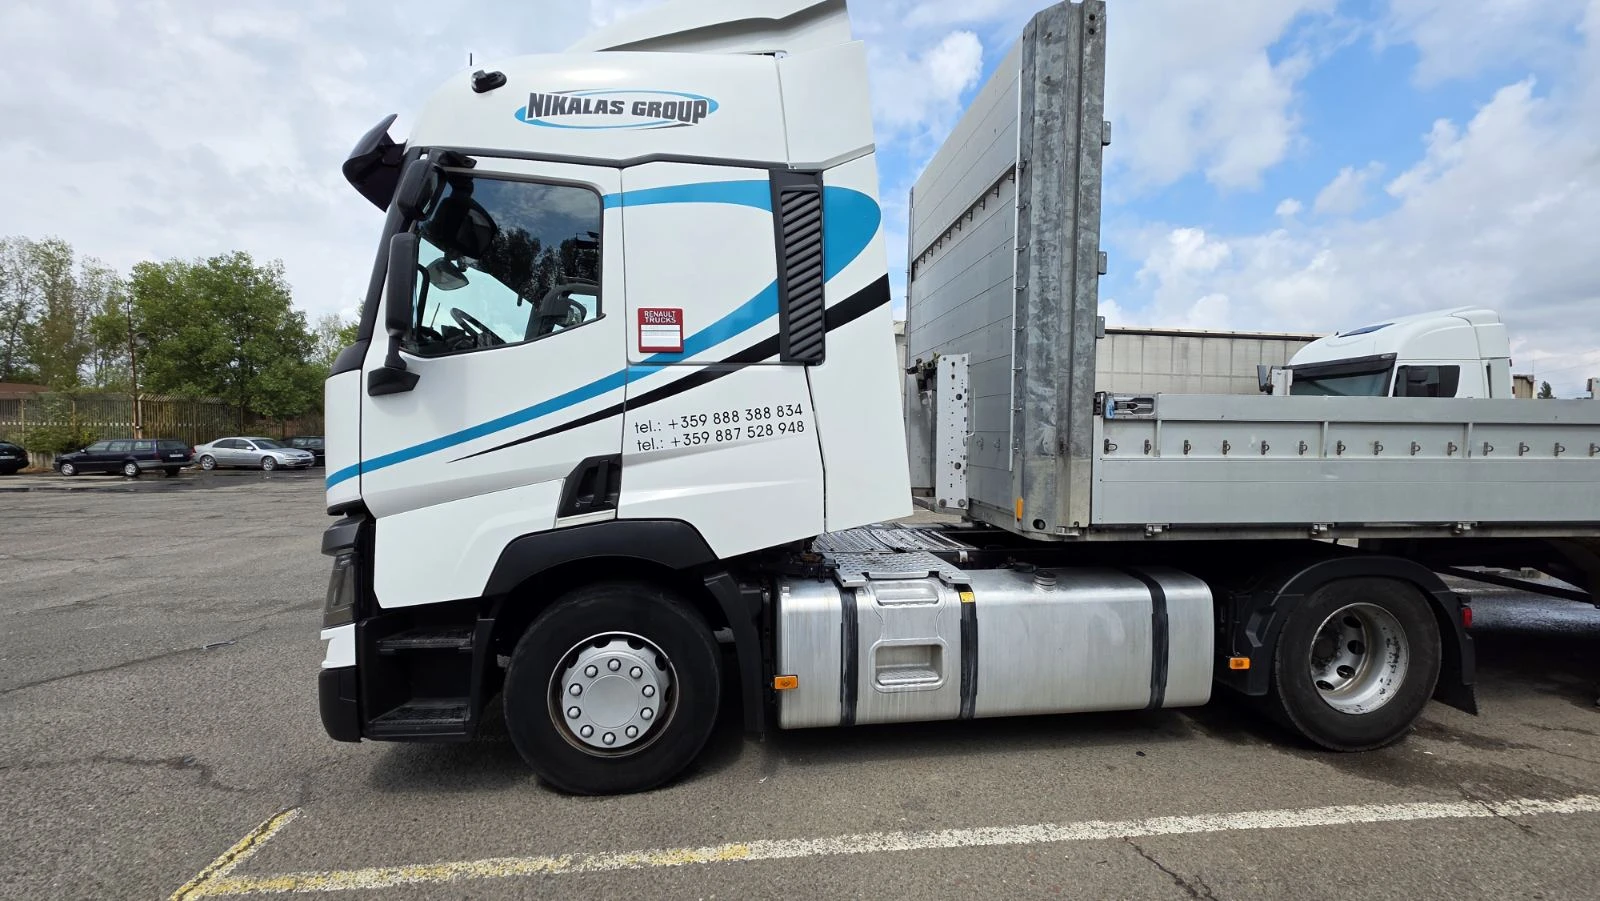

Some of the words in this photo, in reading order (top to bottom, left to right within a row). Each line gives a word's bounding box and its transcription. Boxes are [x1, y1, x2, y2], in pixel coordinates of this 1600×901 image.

[527, 92, 625, 119] NIKALAS
[631, 99, 708, 124] GROUP
[644, 310, 676, 318] RENAULT
[668, 413, 708, 430] +359
[713, 410, 740, 425] 888
[745, 406, 771, 421] 388
[776, 403, 803, 418] 834
[670, 431, 710, 447] +359
[715, 427, 741, 442] 887
[747, 424, 774, 438] 528
[778, 420, 805, 435] 948
